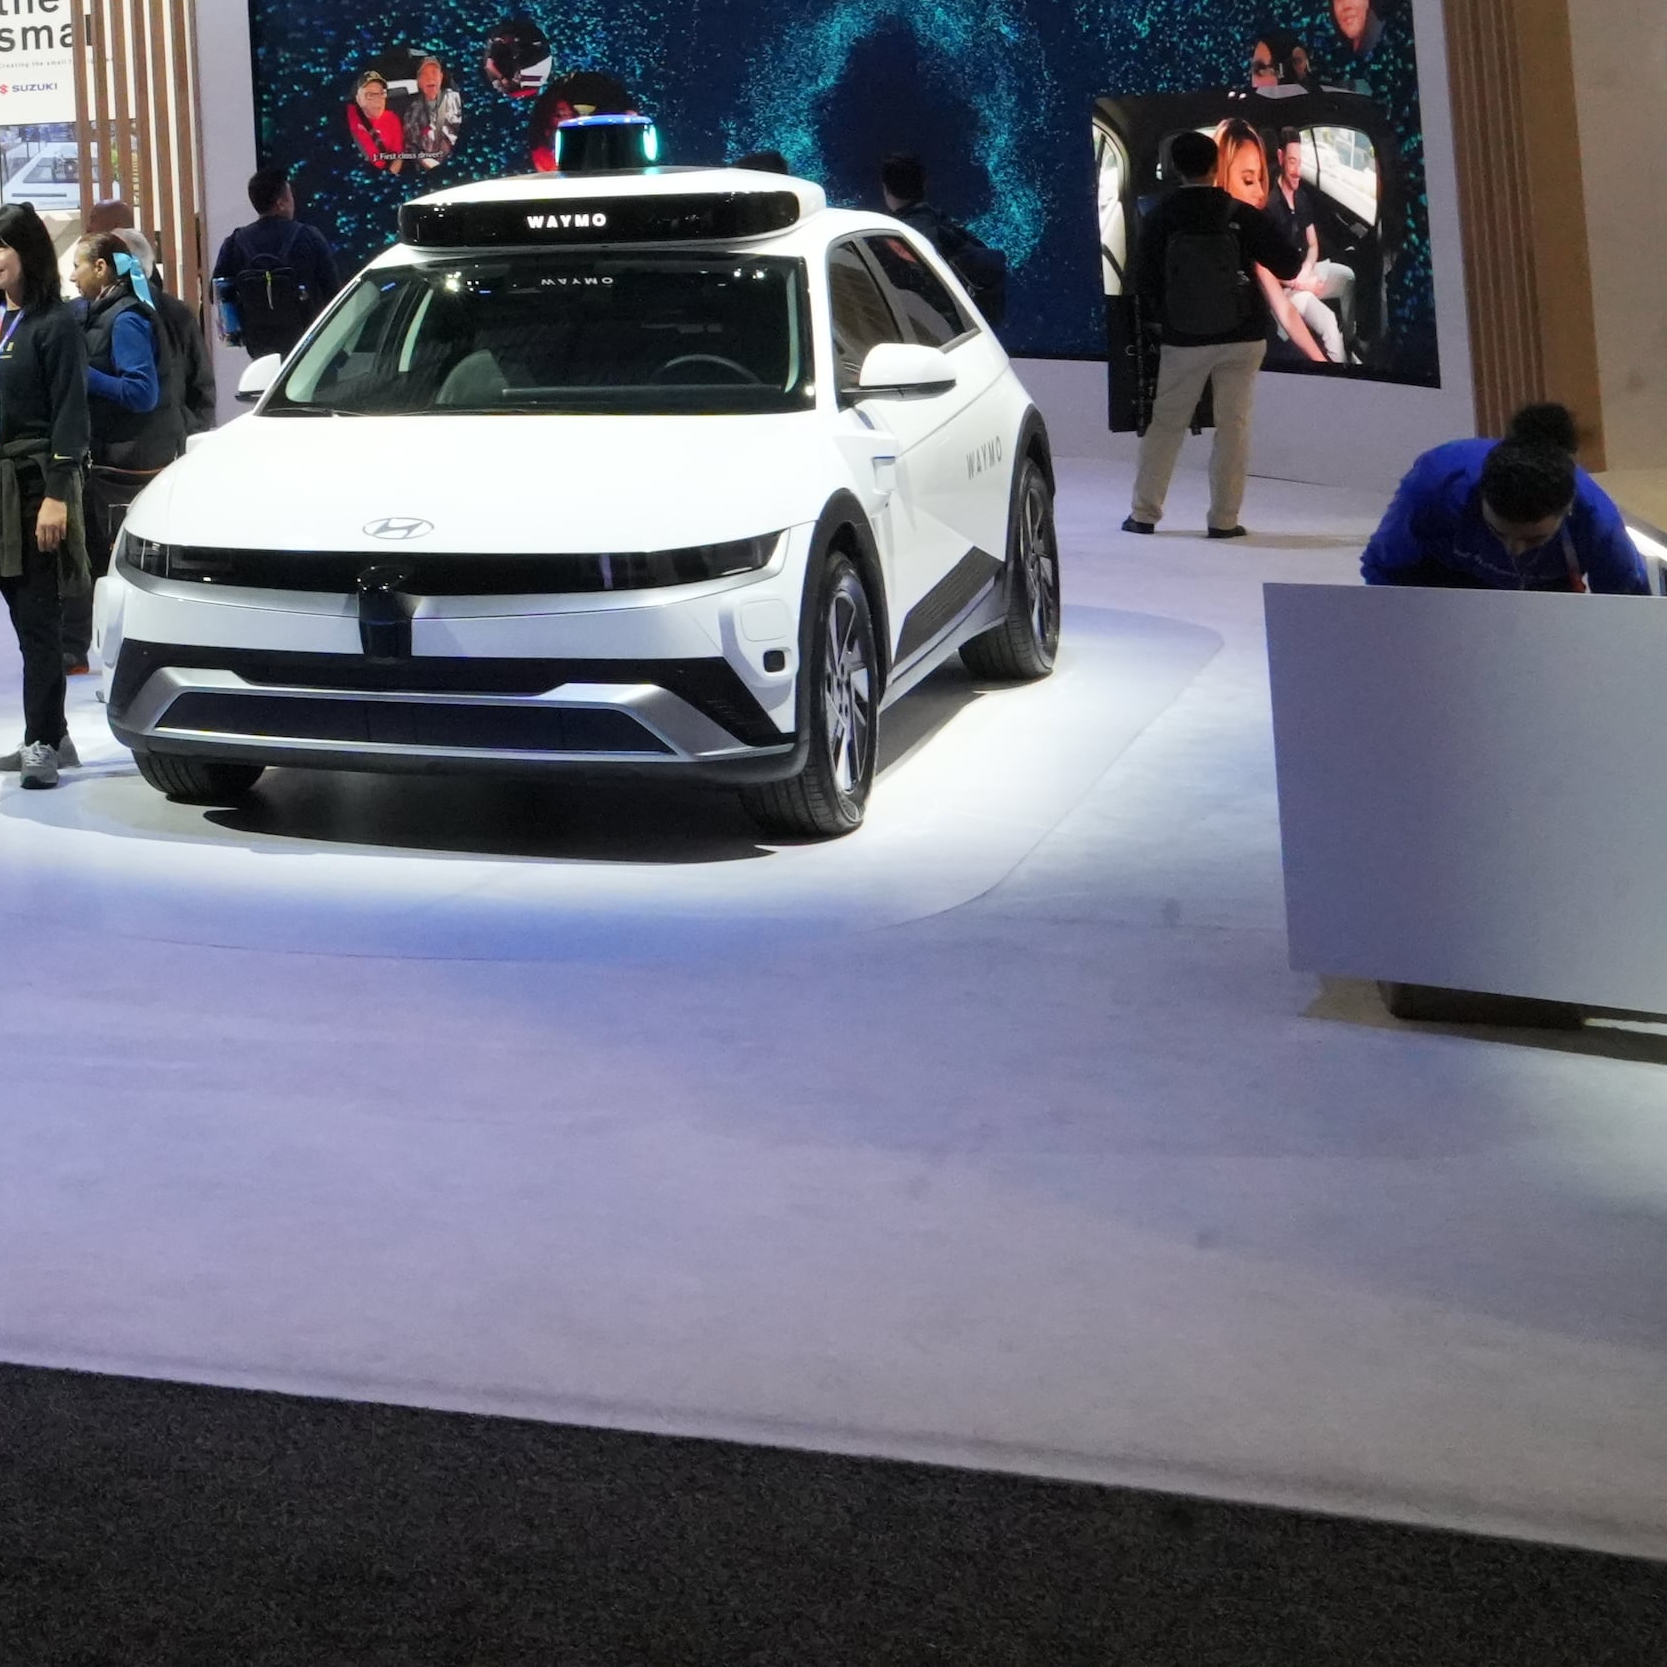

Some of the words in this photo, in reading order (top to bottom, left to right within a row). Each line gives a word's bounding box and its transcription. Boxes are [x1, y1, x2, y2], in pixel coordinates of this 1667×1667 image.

[12, 83, 58, 92] SUZUKI
[380, 152, 396, 160] First
[527, 213, 607, 228] WAYMO
[967, 436, 1002, 481] WAYMO
